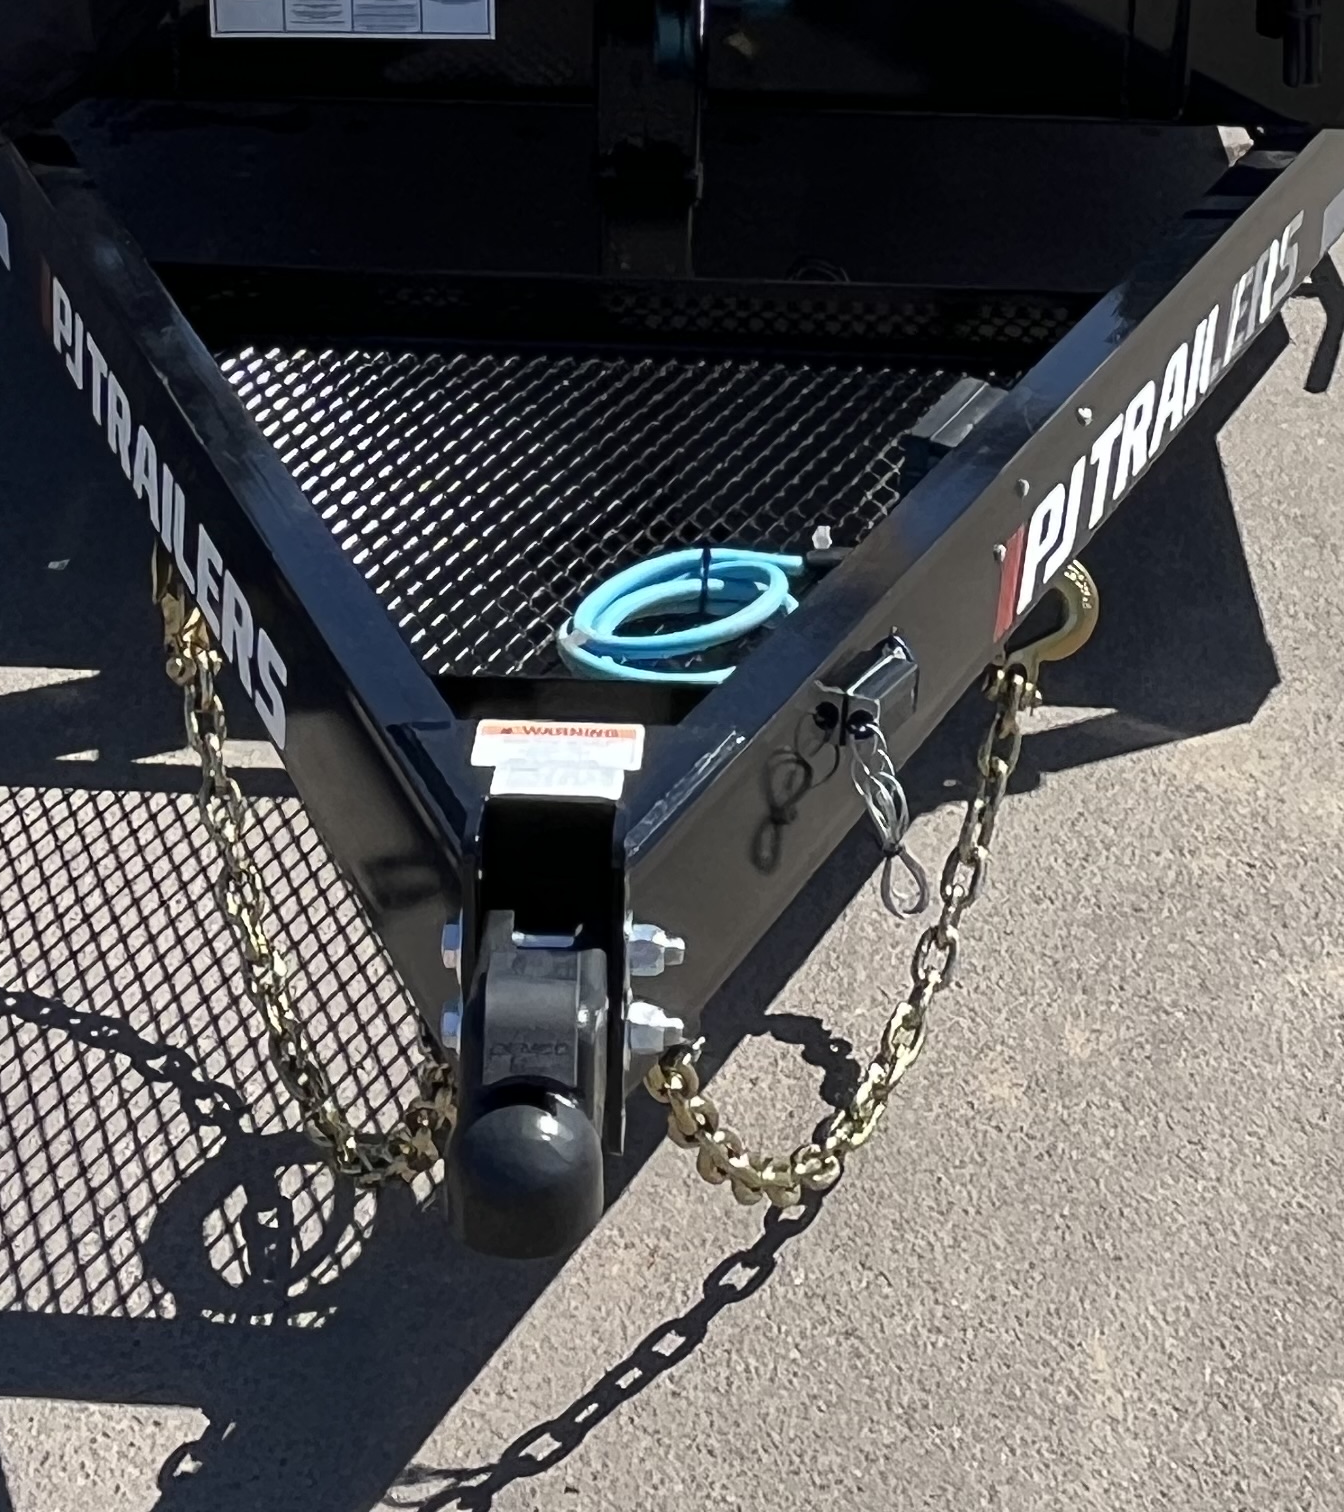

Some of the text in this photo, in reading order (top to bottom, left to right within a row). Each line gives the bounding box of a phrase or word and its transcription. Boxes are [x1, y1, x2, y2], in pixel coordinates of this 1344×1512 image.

[53, 276, 288, 750] PJ TRAILERS
[1017, 209, 1305, 615] PJ TRAILERS
